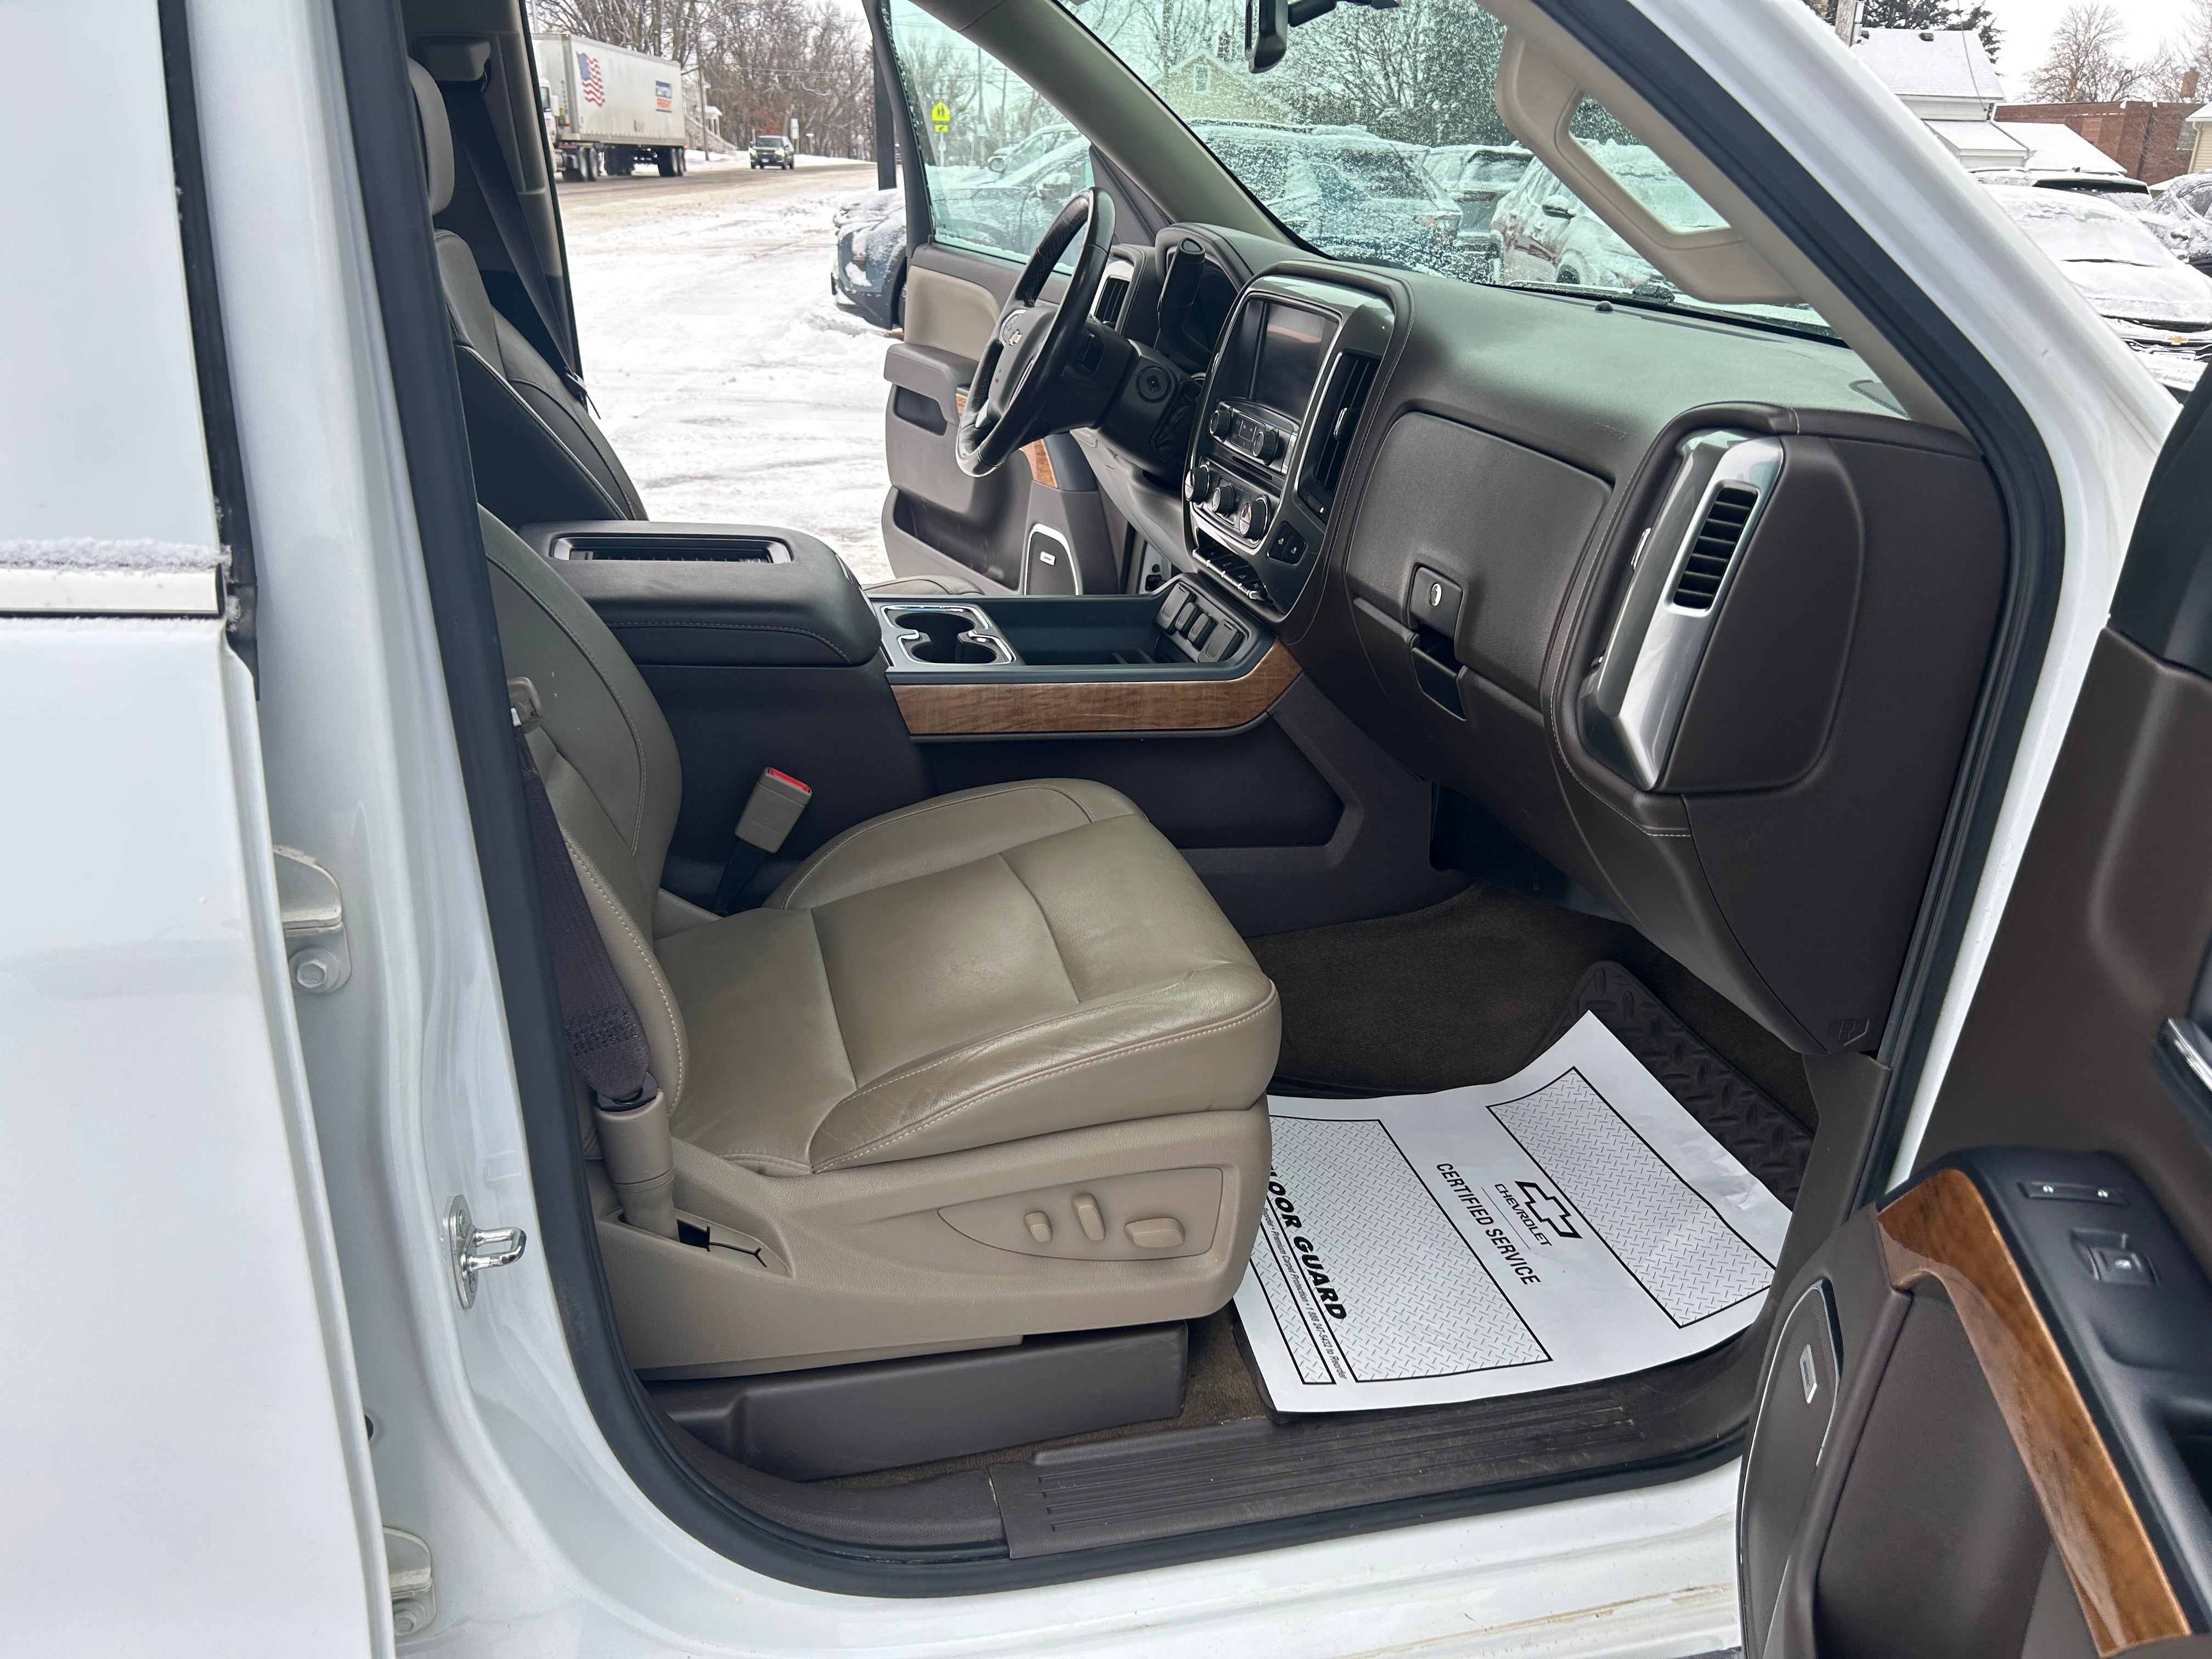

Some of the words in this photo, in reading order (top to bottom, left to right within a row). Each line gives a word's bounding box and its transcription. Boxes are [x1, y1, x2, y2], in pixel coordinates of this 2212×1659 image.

[1268, 1166, 1302, 1228] OOR
[1293, 1236, 1347, 1319] GUARD
[1436, 1163, 1494, 1225] CERTIFIED
[1485, 1228, 1541, 1285] SERVICE
[1494, 1183, 1552, 1246] CHEVROLET
[1271, 1231, 1286, 1254] Premium
[1282, 1255, 1296, 1273] Carpet
[1290, 1273, 1308, 1302] Protection
[1329, 1356, 1347, 1380] Reorder
